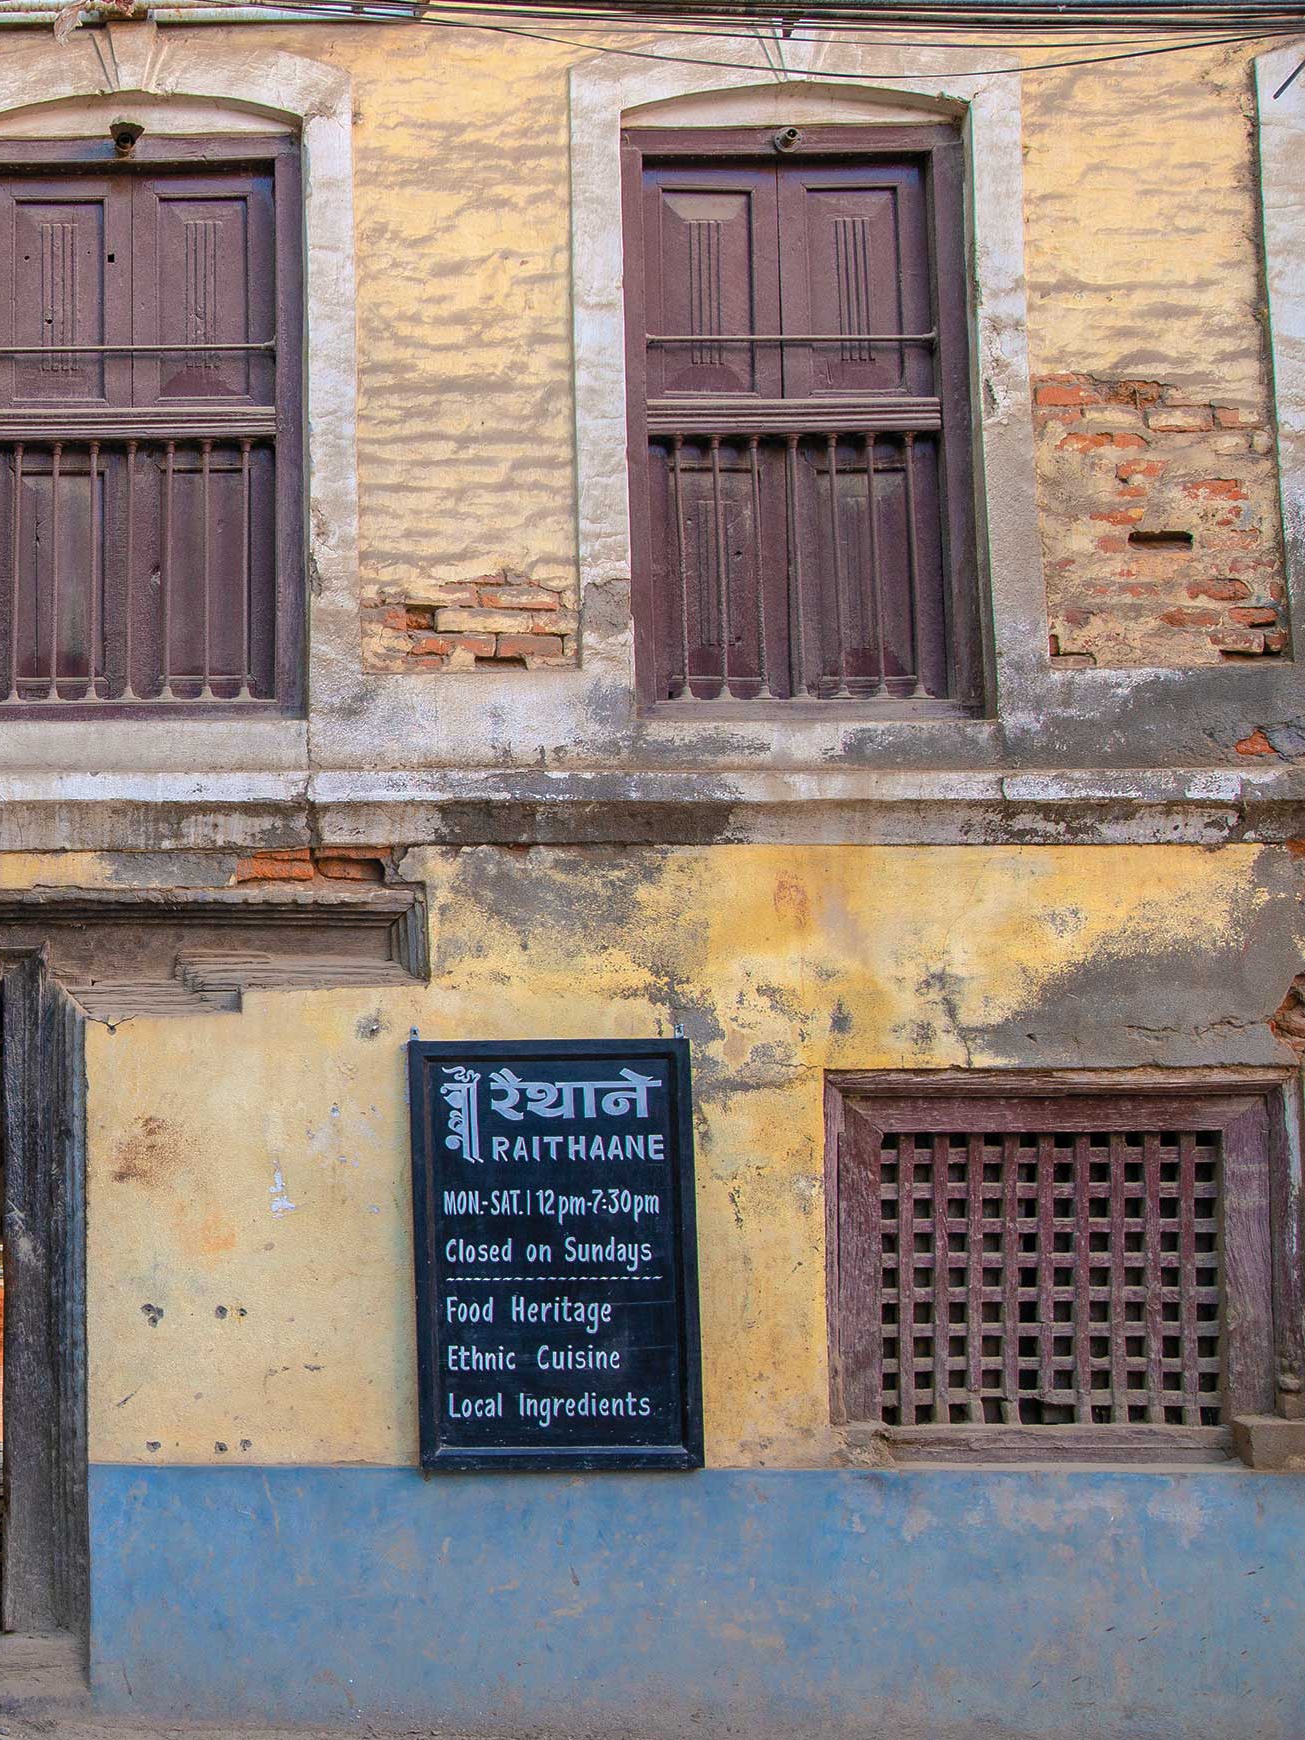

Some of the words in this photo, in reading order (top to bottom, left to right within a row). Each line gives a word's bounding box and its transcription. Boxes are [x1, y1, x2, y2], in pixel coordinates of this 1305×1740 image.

[489, 1067, 662, 1121] रैथाने
[491, 1134, 665, 1162] RAITHAANE
[445, 1237, 512, 1263] Closed
[526, 1243, 552, 1263] on
[564, 1236, 652, 1272] Sundays
[446, 1296, 494, 1323] Food
[511, 1295, 613, 1333] Heritage
[448, 1345, 516, 1371] Ethnic
[537, 1344, 621, 1371] Cuisine
[449, 1392, 503, 1418] Local
[519, 1391, 651, 1427] Ingredients
